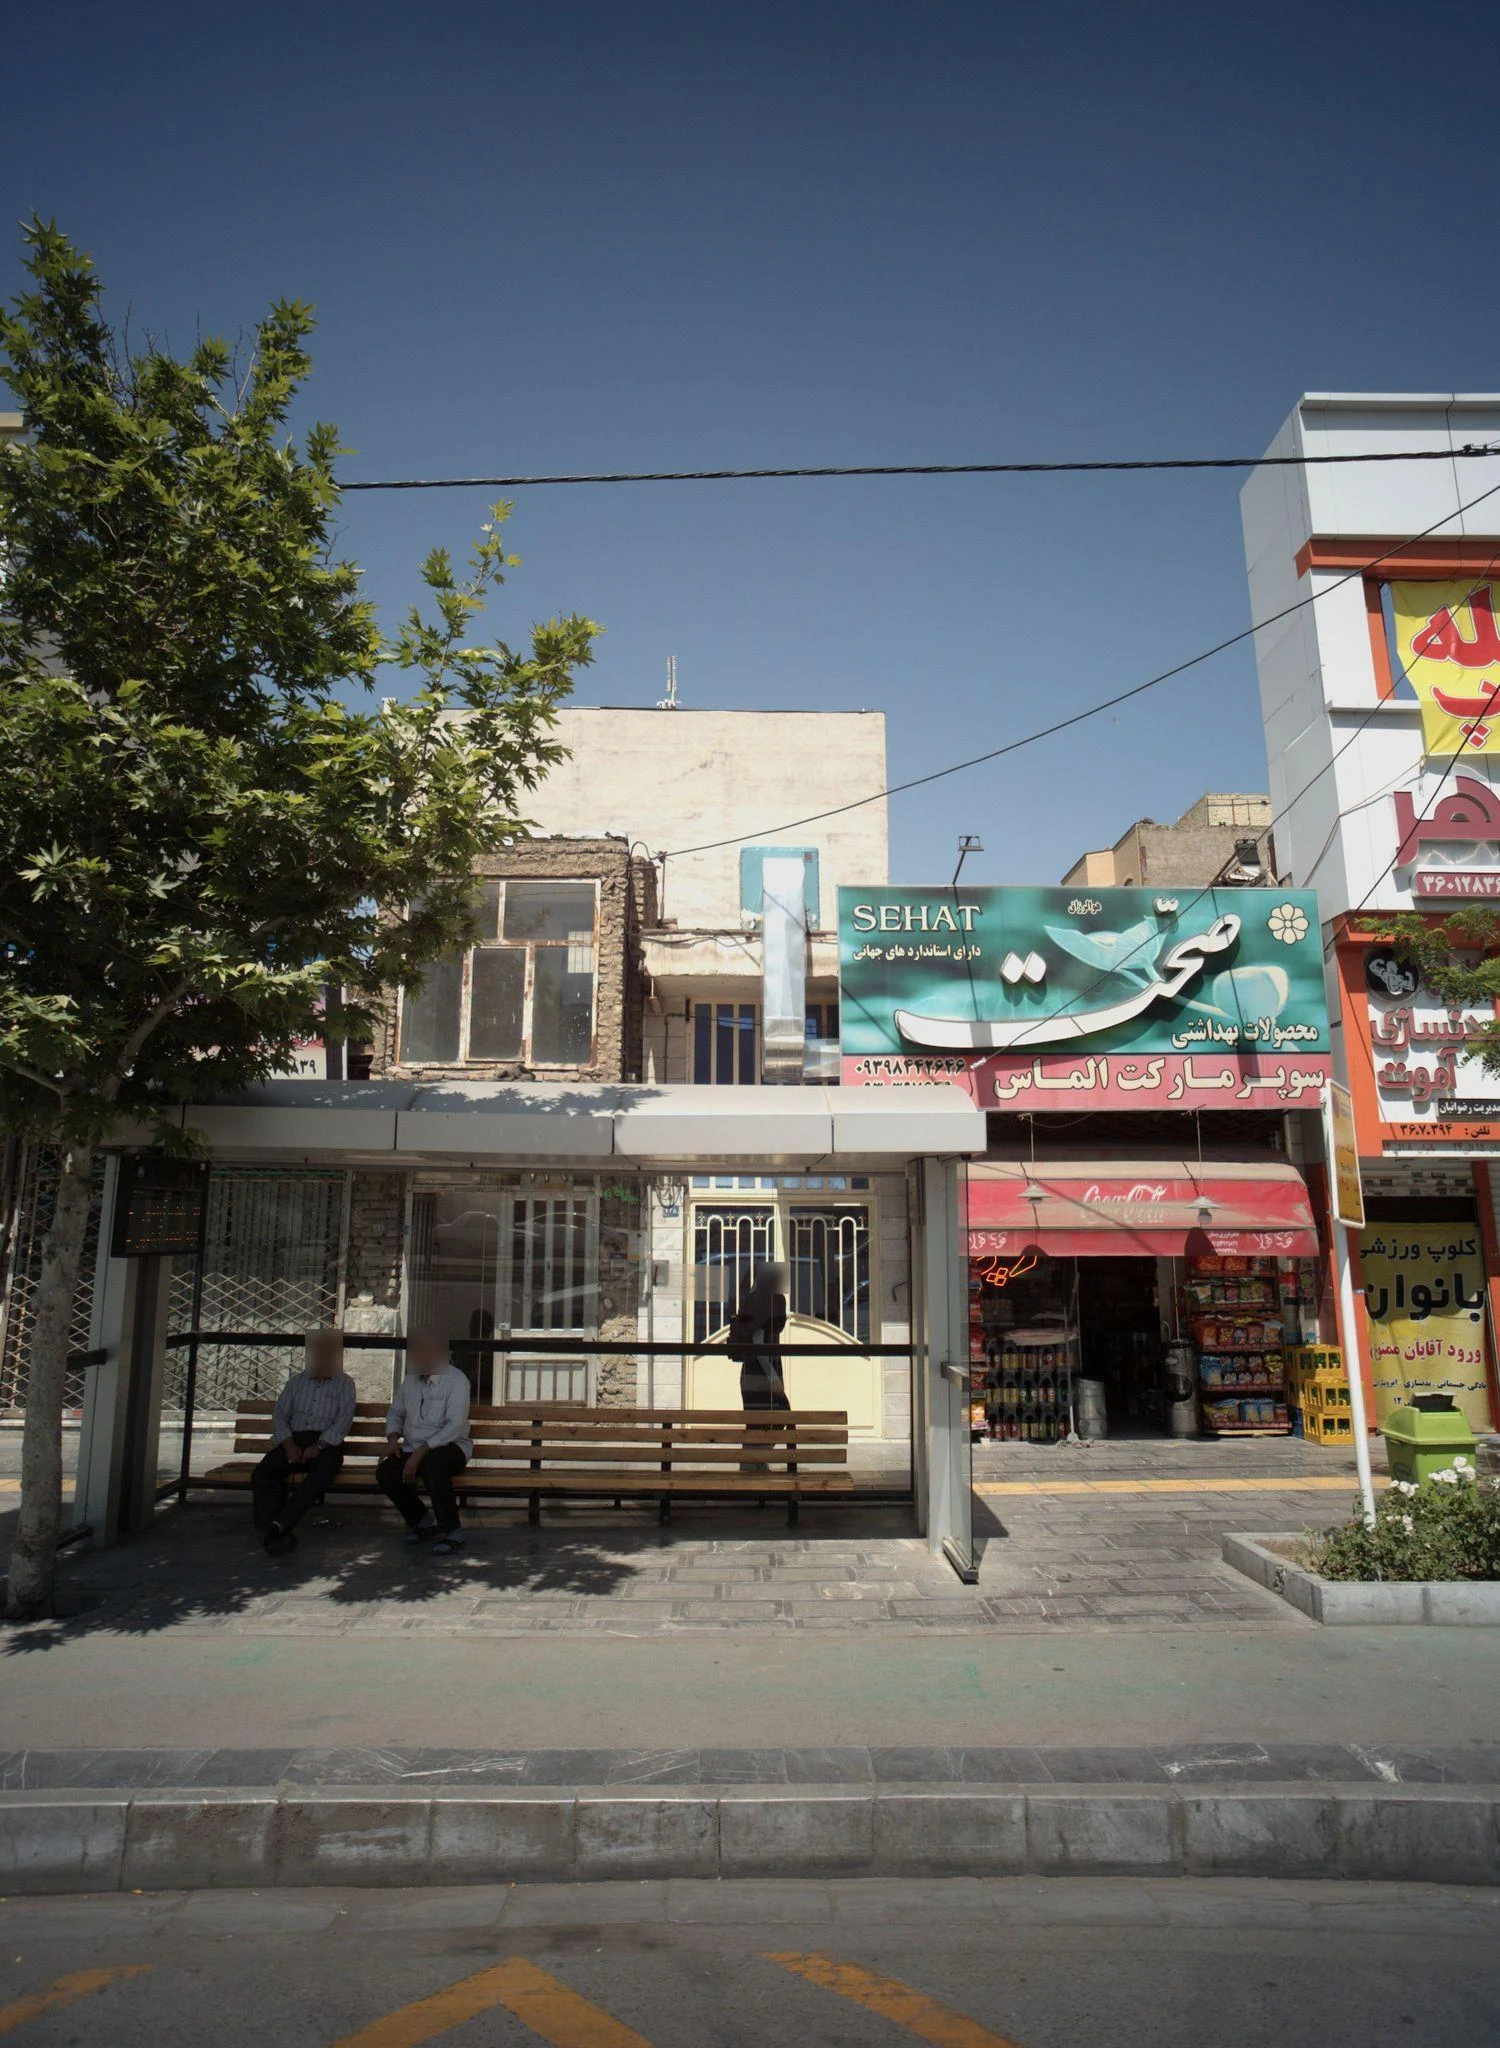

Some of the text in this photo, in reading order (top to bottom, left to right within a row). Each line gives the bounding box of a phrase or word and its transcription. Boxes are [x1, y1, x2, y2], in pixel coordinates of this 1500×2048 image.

[853, 904, 982, 932] SEHAT
[853, 943, 981, 960] دارای استاندارد های جهانی
[1172, 1016, 1320, 1049] محصولات بهداشتی
[1371, 1004, 1500, 1052] دنسازی
[993, 1056, 1110, 1100] الماس
[1426, 1238, 1476, 1263] کلوپ
[1365, 1272, 1485, 1323] بانوان
[1404, 1339, 1444, 1361] آقایان
[1447, 1343, 1482, 1364] ورود
